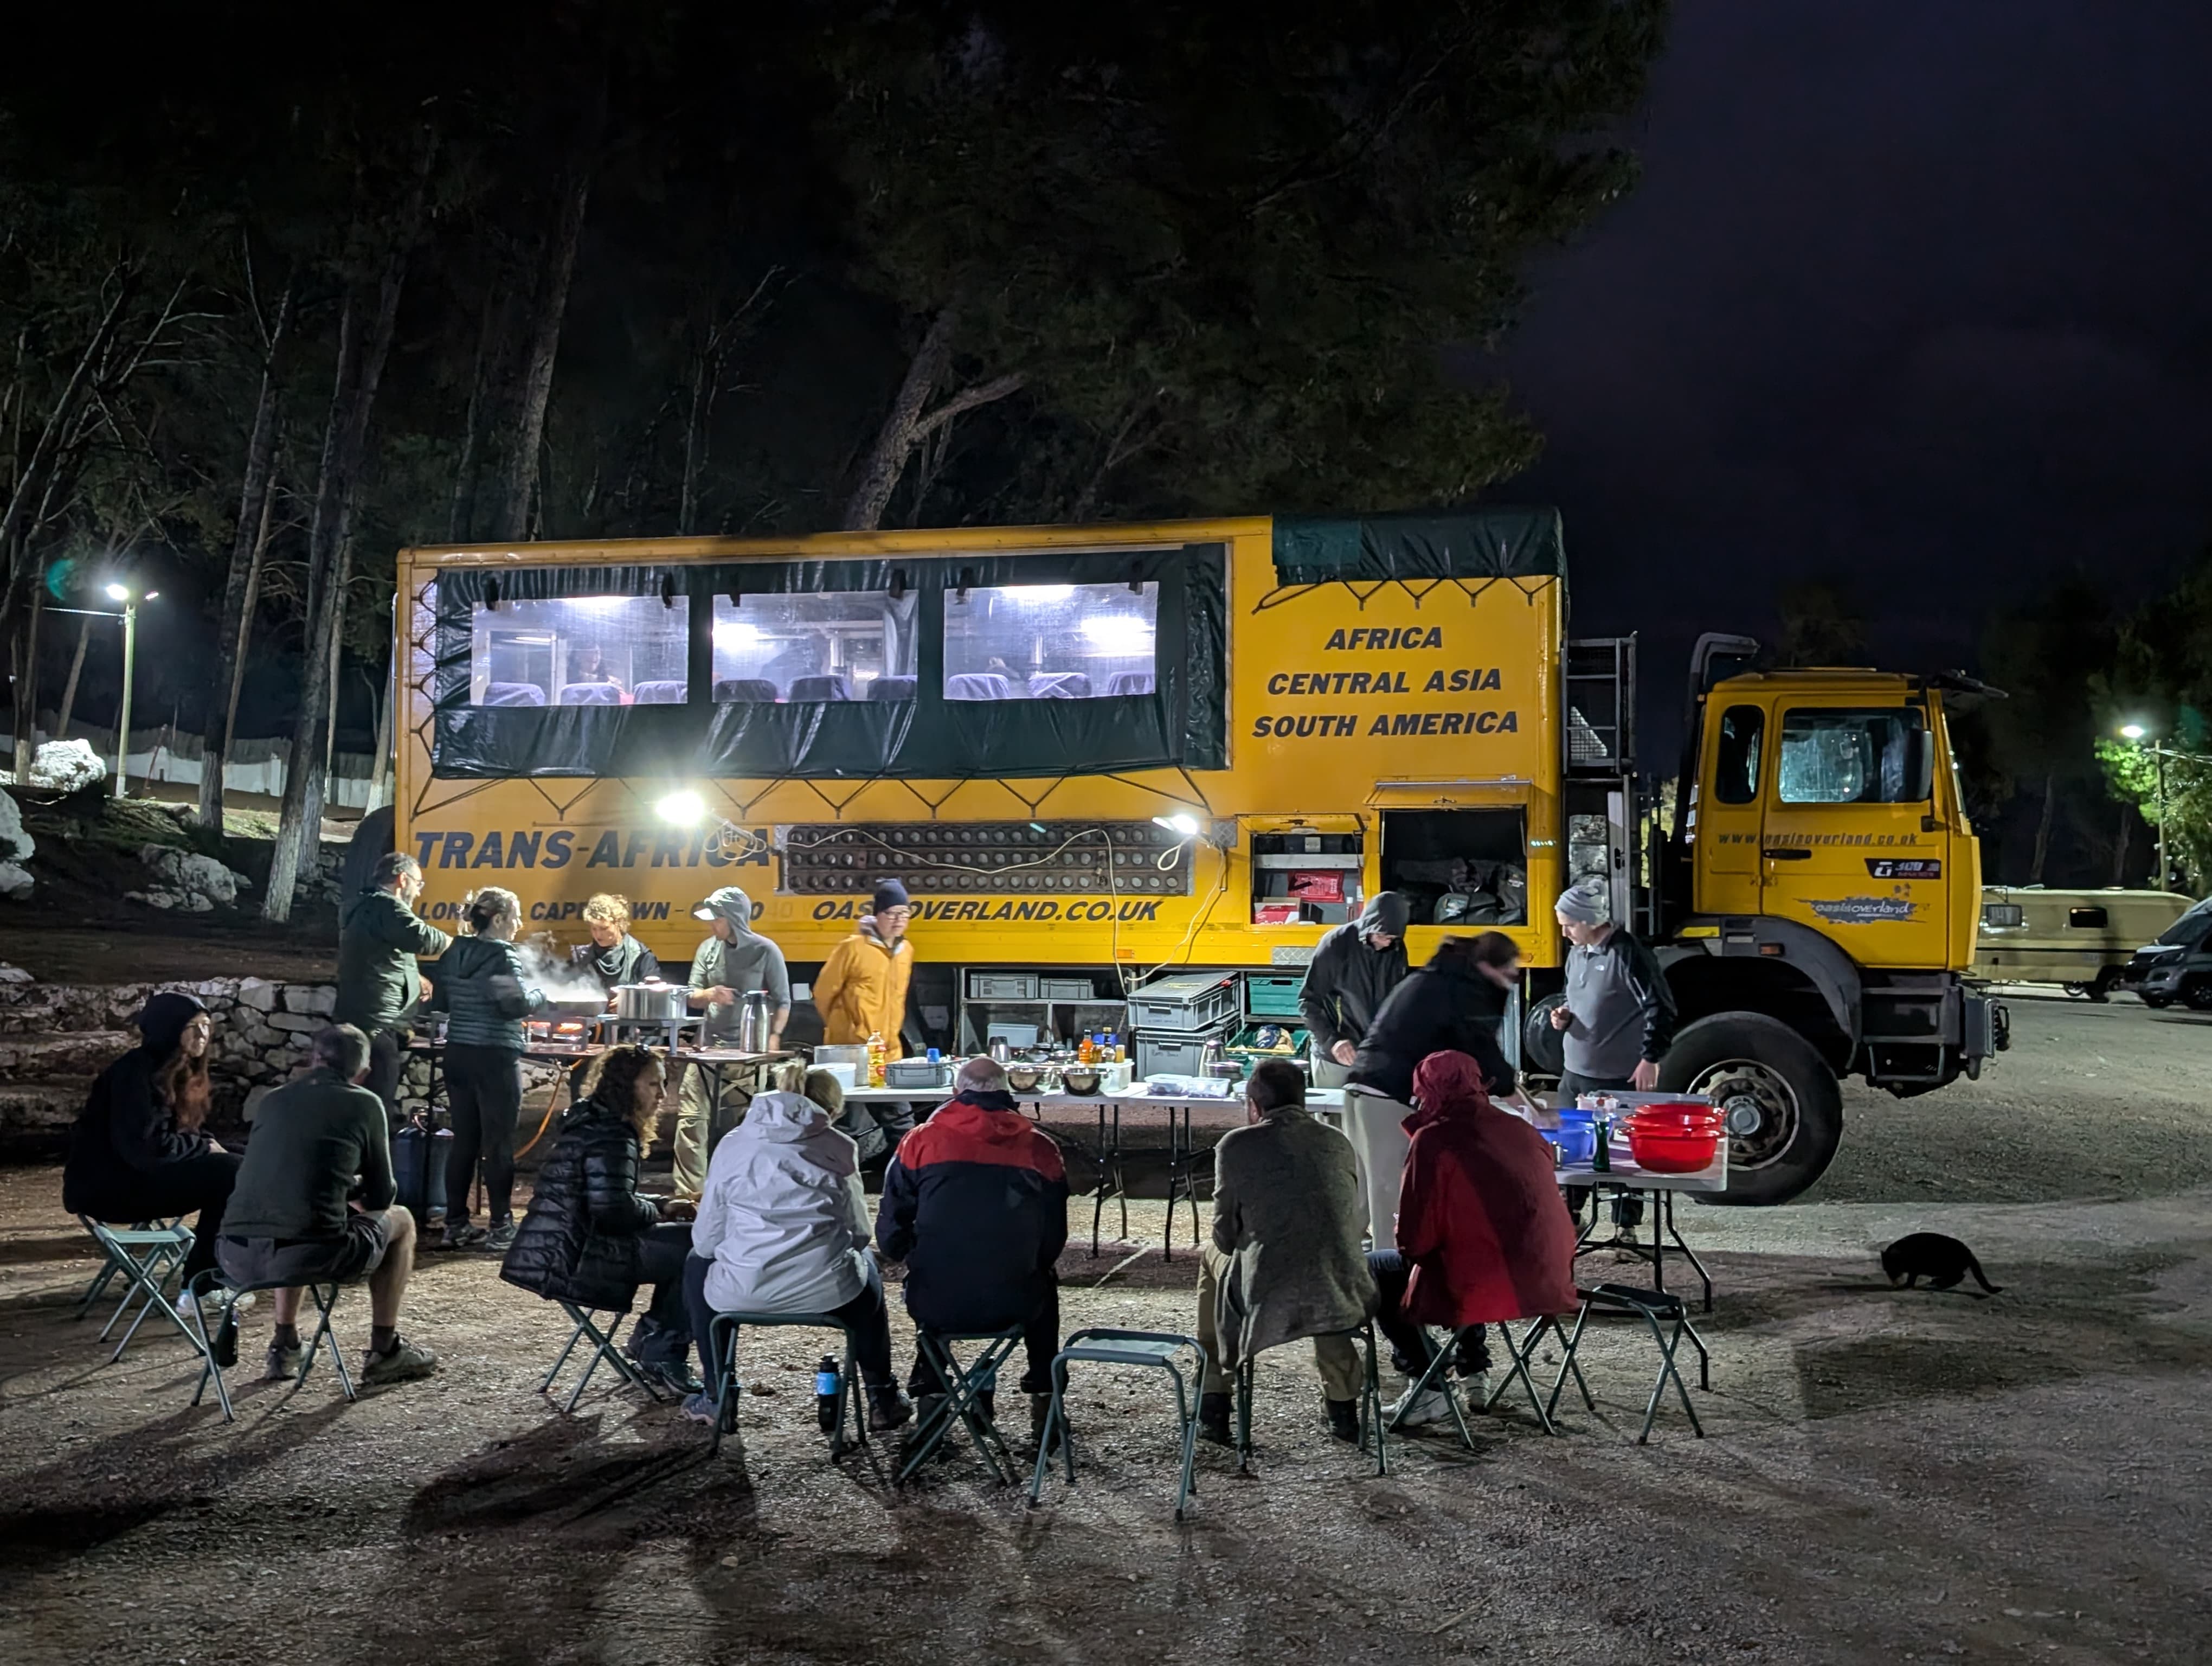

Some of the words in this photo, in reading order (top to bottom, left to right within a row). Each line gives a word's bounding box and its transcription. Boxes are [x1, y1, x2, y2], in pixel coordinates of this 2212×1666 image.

[1324, 627, 1442, 650] AFRICA
[1268, 671, 1410, 695] CENTRAL
[1423, 669, 1501, 693] ASIA
[1252, 715, 1358, 738] SOUTH
[1368, 711, 1518, 736] AMERICA
[415, 828, 769, 869] TRANS-AFRICA
[812, 901, 1165, 921] OASOVERLAND.CO.UK
